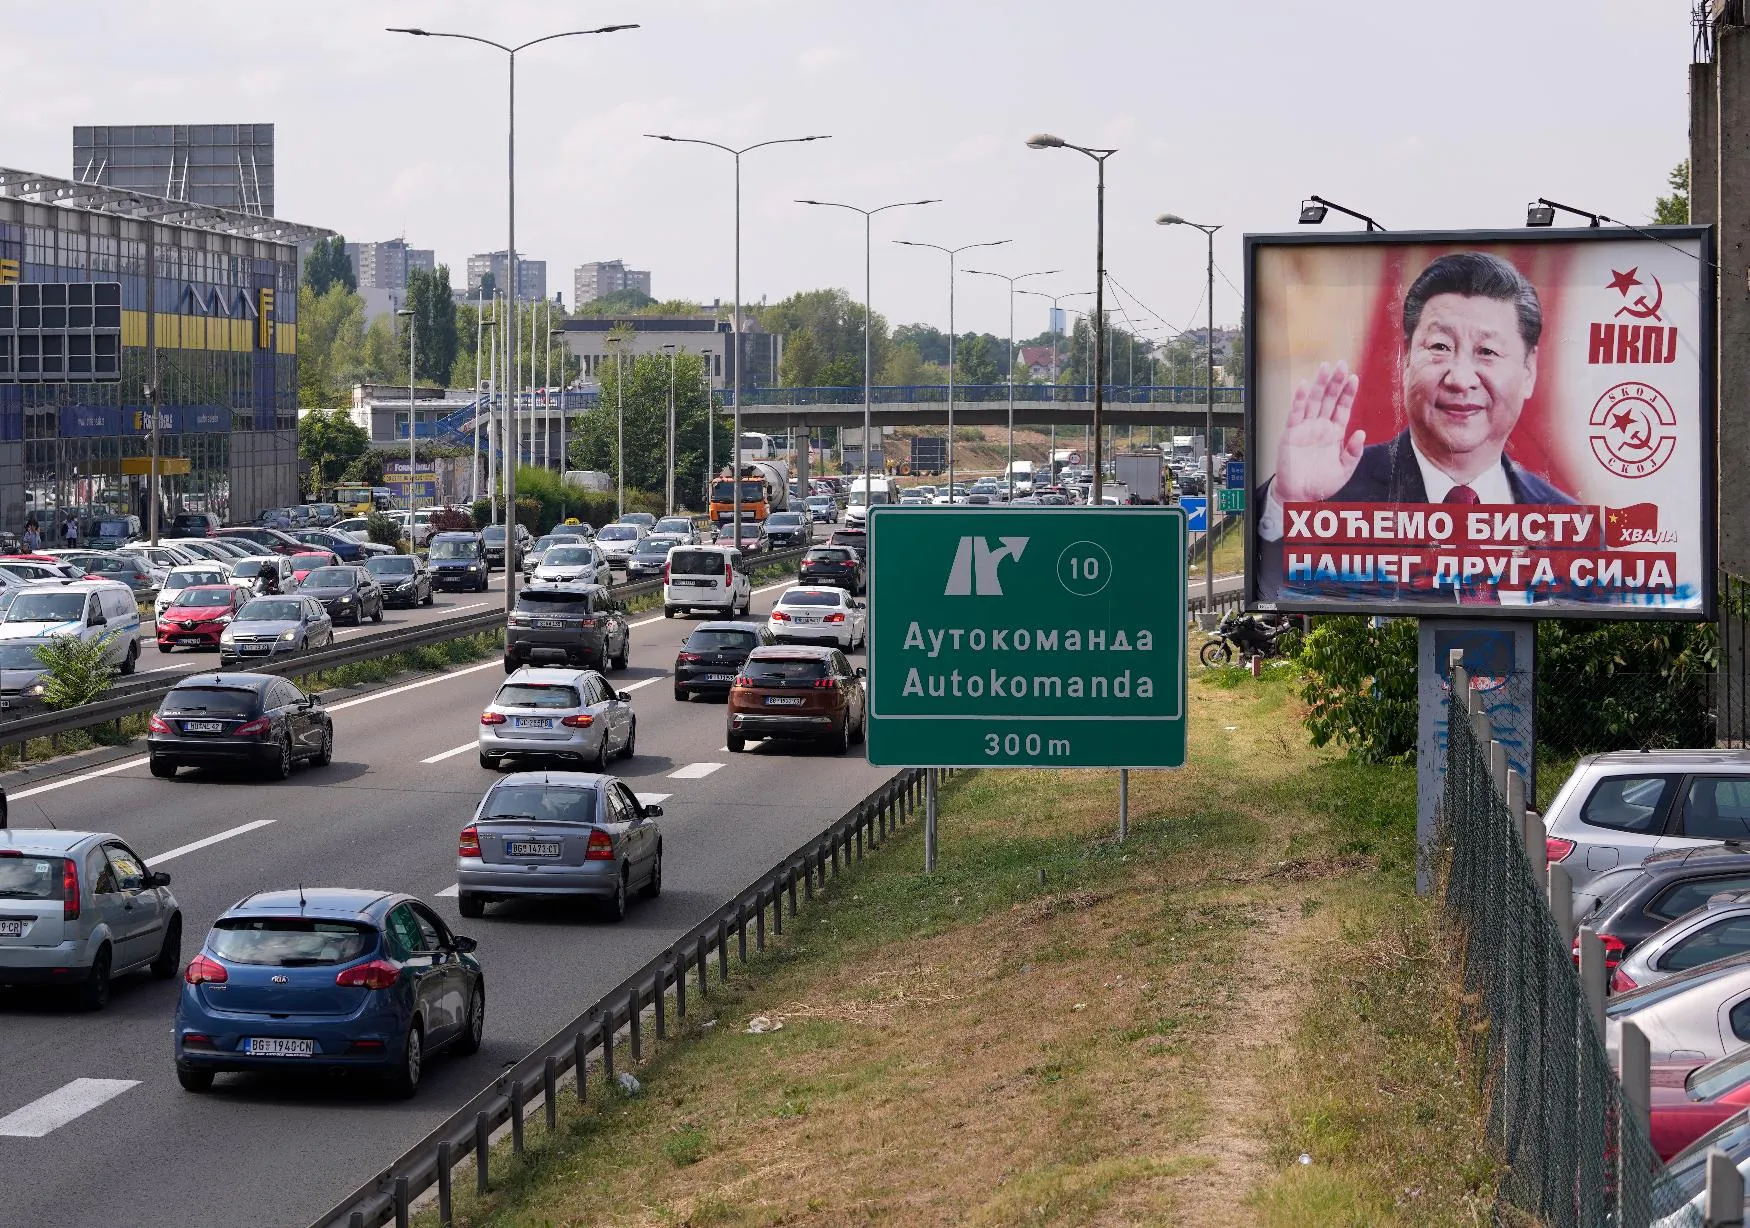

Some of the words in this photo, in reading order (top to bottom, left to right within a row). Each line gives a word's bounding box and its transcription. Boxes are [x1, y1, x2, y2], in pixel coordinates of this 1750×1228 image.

[1588, 322, 1678, 365] НКПЈ
[1608, 387, 1658, 403] SKOJ
[1607, 457, 1657, 474] СКОЈ
[1287, 510, 1453, 540] ХОЋЕМО
[1467, 512, 1594, 542] БИСТУ
[1618, 528, 1678, 544] ХВАЛА
[1070, 557, 1099, 580] 10
[1288, 553, 1422, 583] НАШЕГ
[1432, 555, 1557, 590] ДРУГА
[1569, 558, 1674, 589] СИЈА
[902, 621, 1154, 658] Аутокоманда
[901, 667, 1154, 699] Autokomanda
